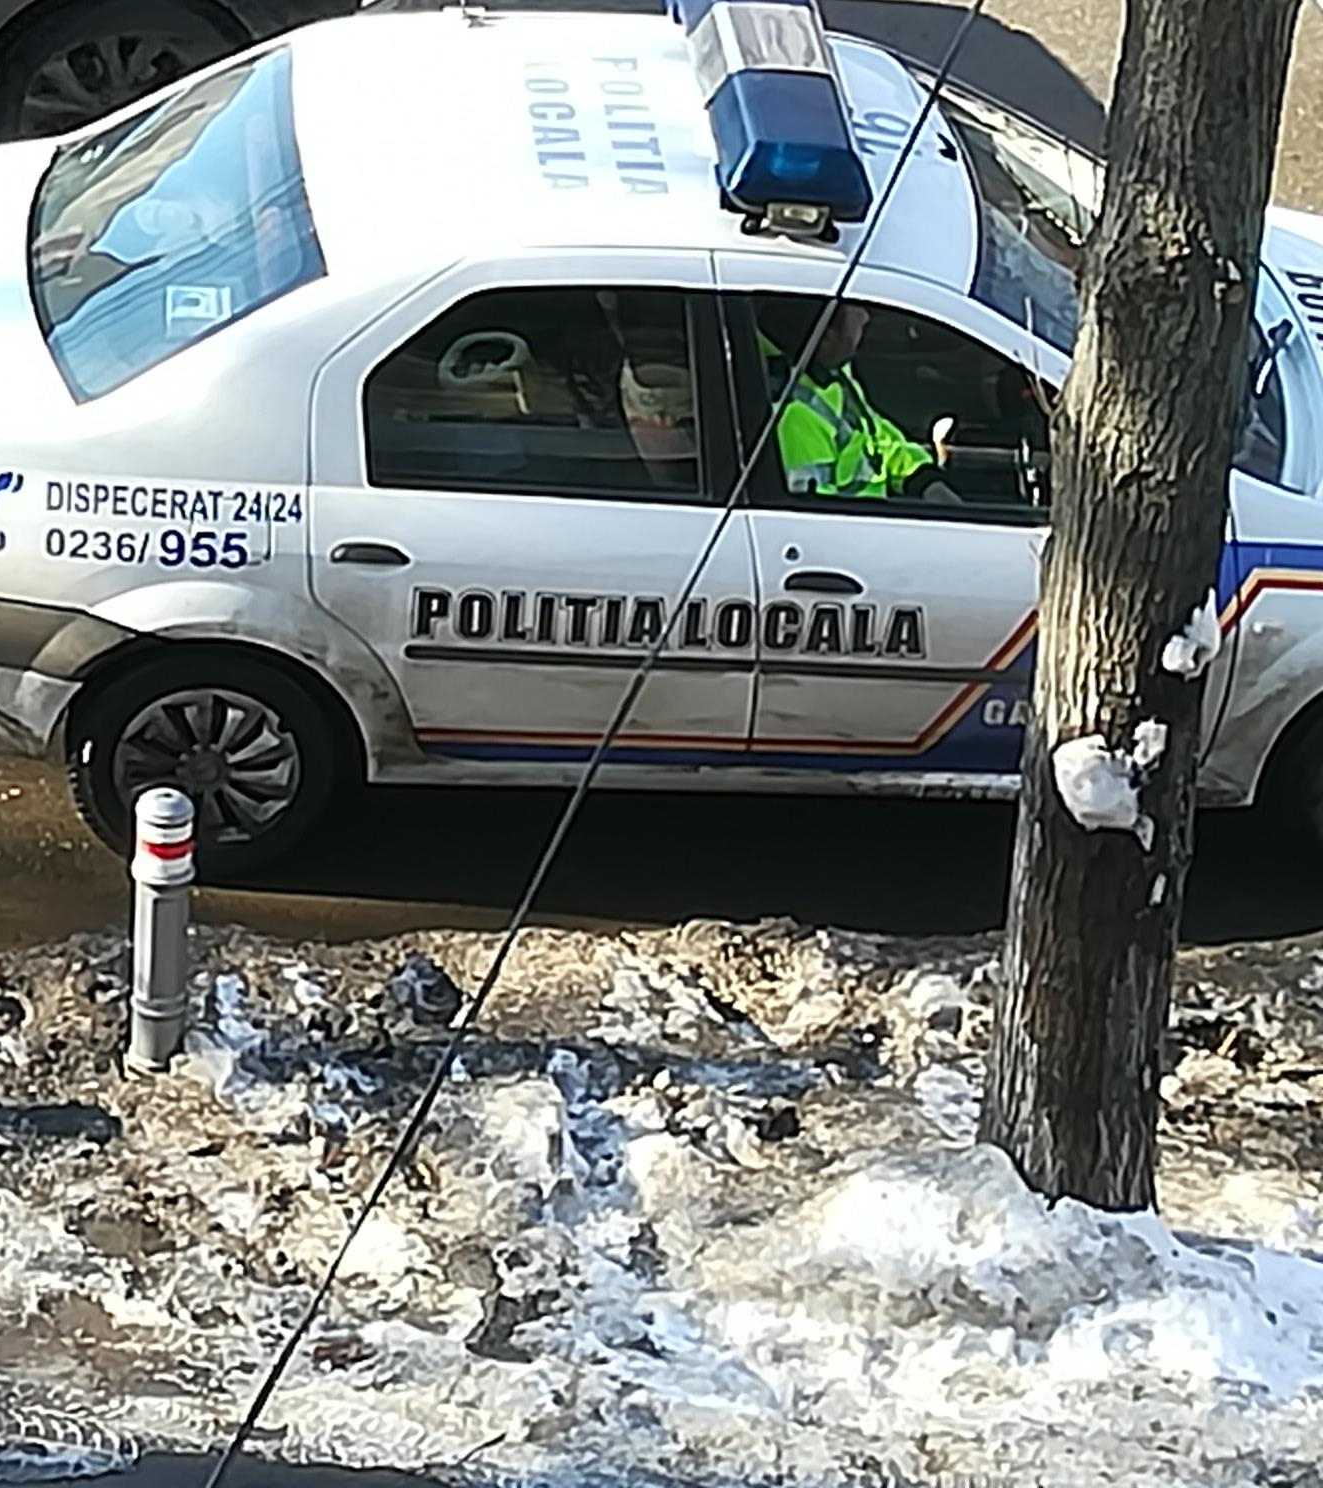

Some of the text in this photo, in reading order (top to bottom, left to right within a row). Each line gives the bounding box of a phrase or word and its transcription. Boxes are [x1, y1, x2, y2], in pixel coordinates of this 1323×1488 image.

[592, 57, 669, 194] POLITIA
[45, 481, 303, 523] DISPECERAT 24/24
[412, 586, 928, 659] POLITIA LOCALA
